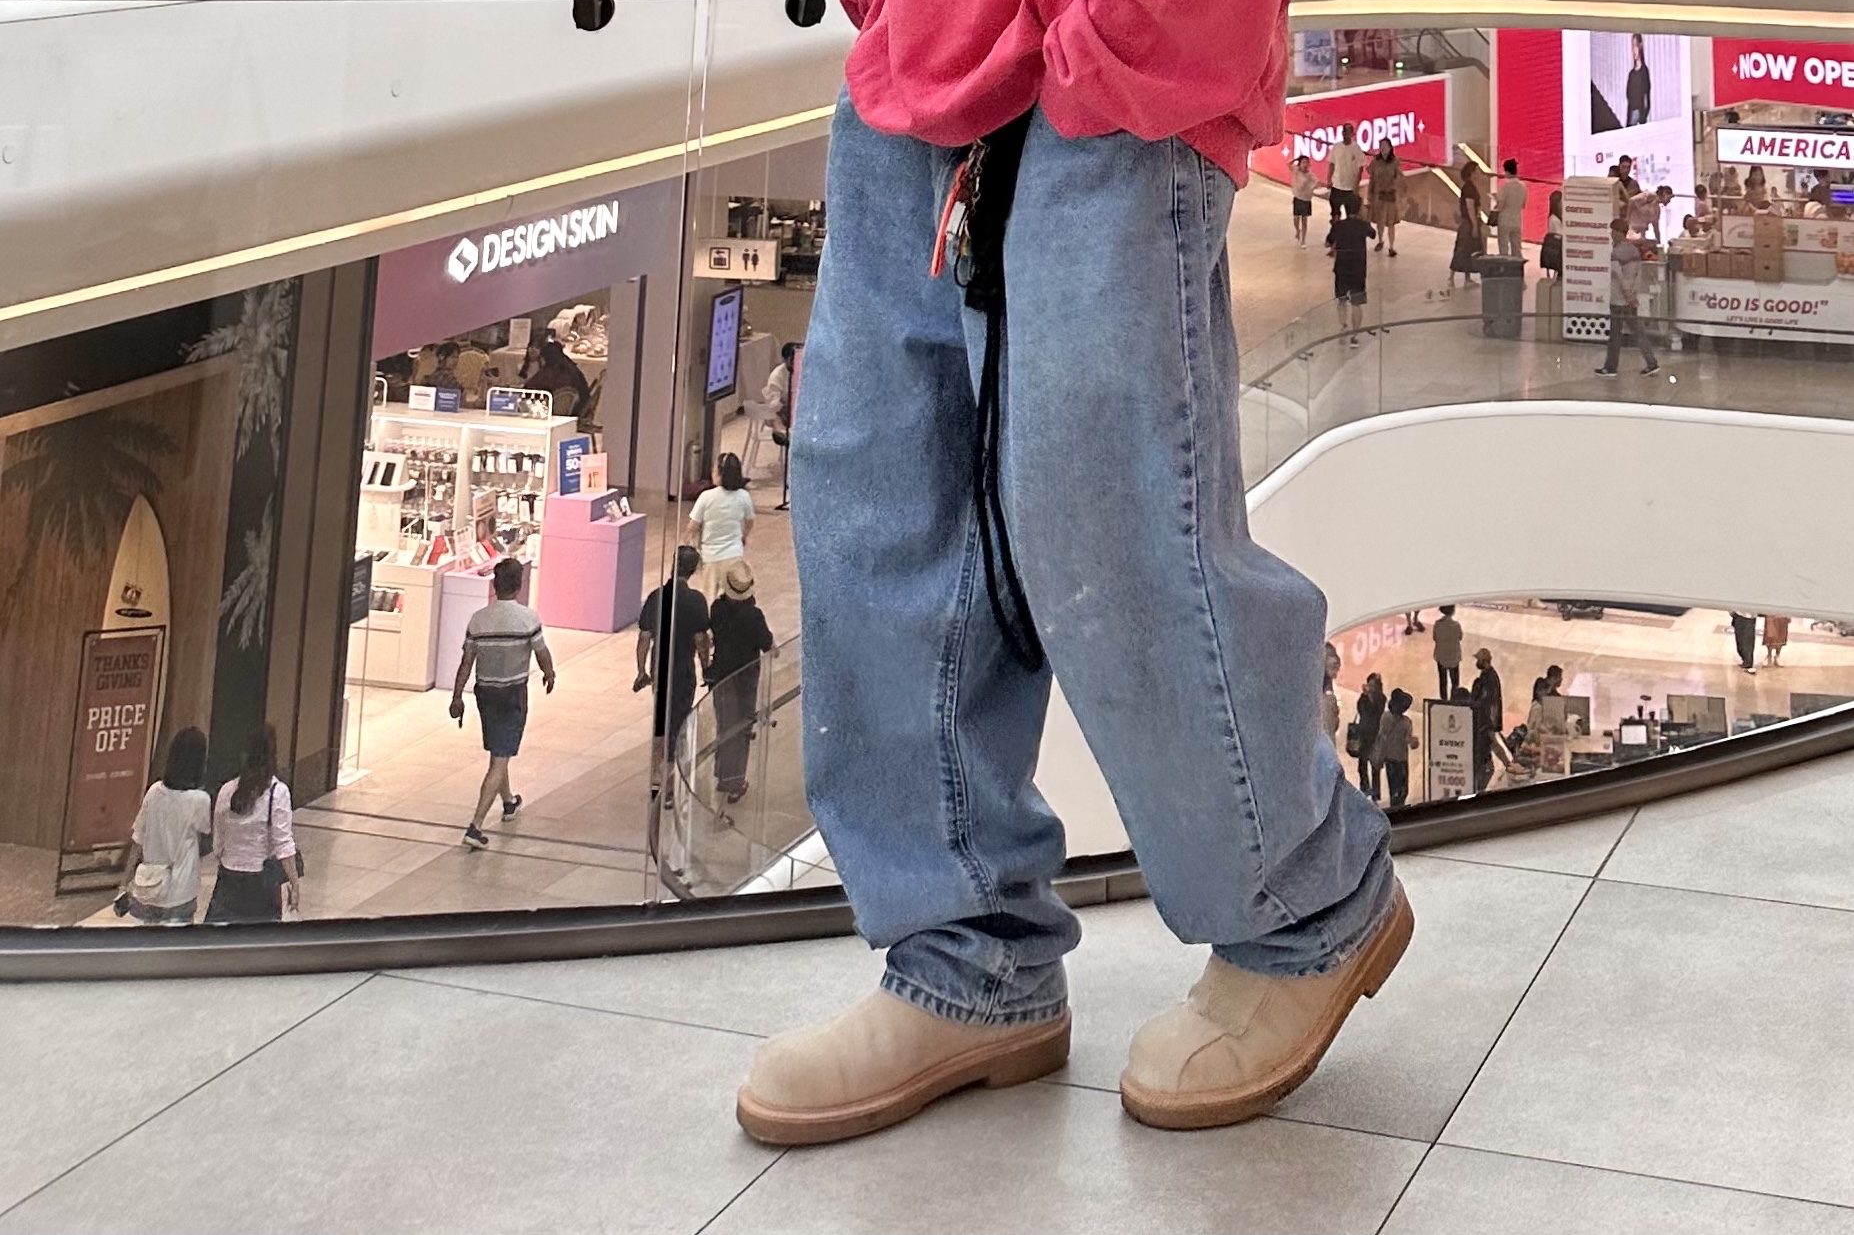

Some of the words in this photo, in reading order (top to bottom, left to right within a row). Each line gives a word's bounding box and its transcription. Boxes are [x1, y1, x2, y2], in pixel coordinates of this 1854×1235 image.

[1739, 51, 1797, 82] NOW
[1356, 111, 1416, 153] OPEN
[1740, 135, 1854, 161] AMERICA
[1744, 297, 1760, 312] IS
[93, 652, 150, 672] THANKS
[95, 670, 143, 691] GIVING
[87, 703, 146, 730] PRICE
[95, 727, 133, 754] OFF
